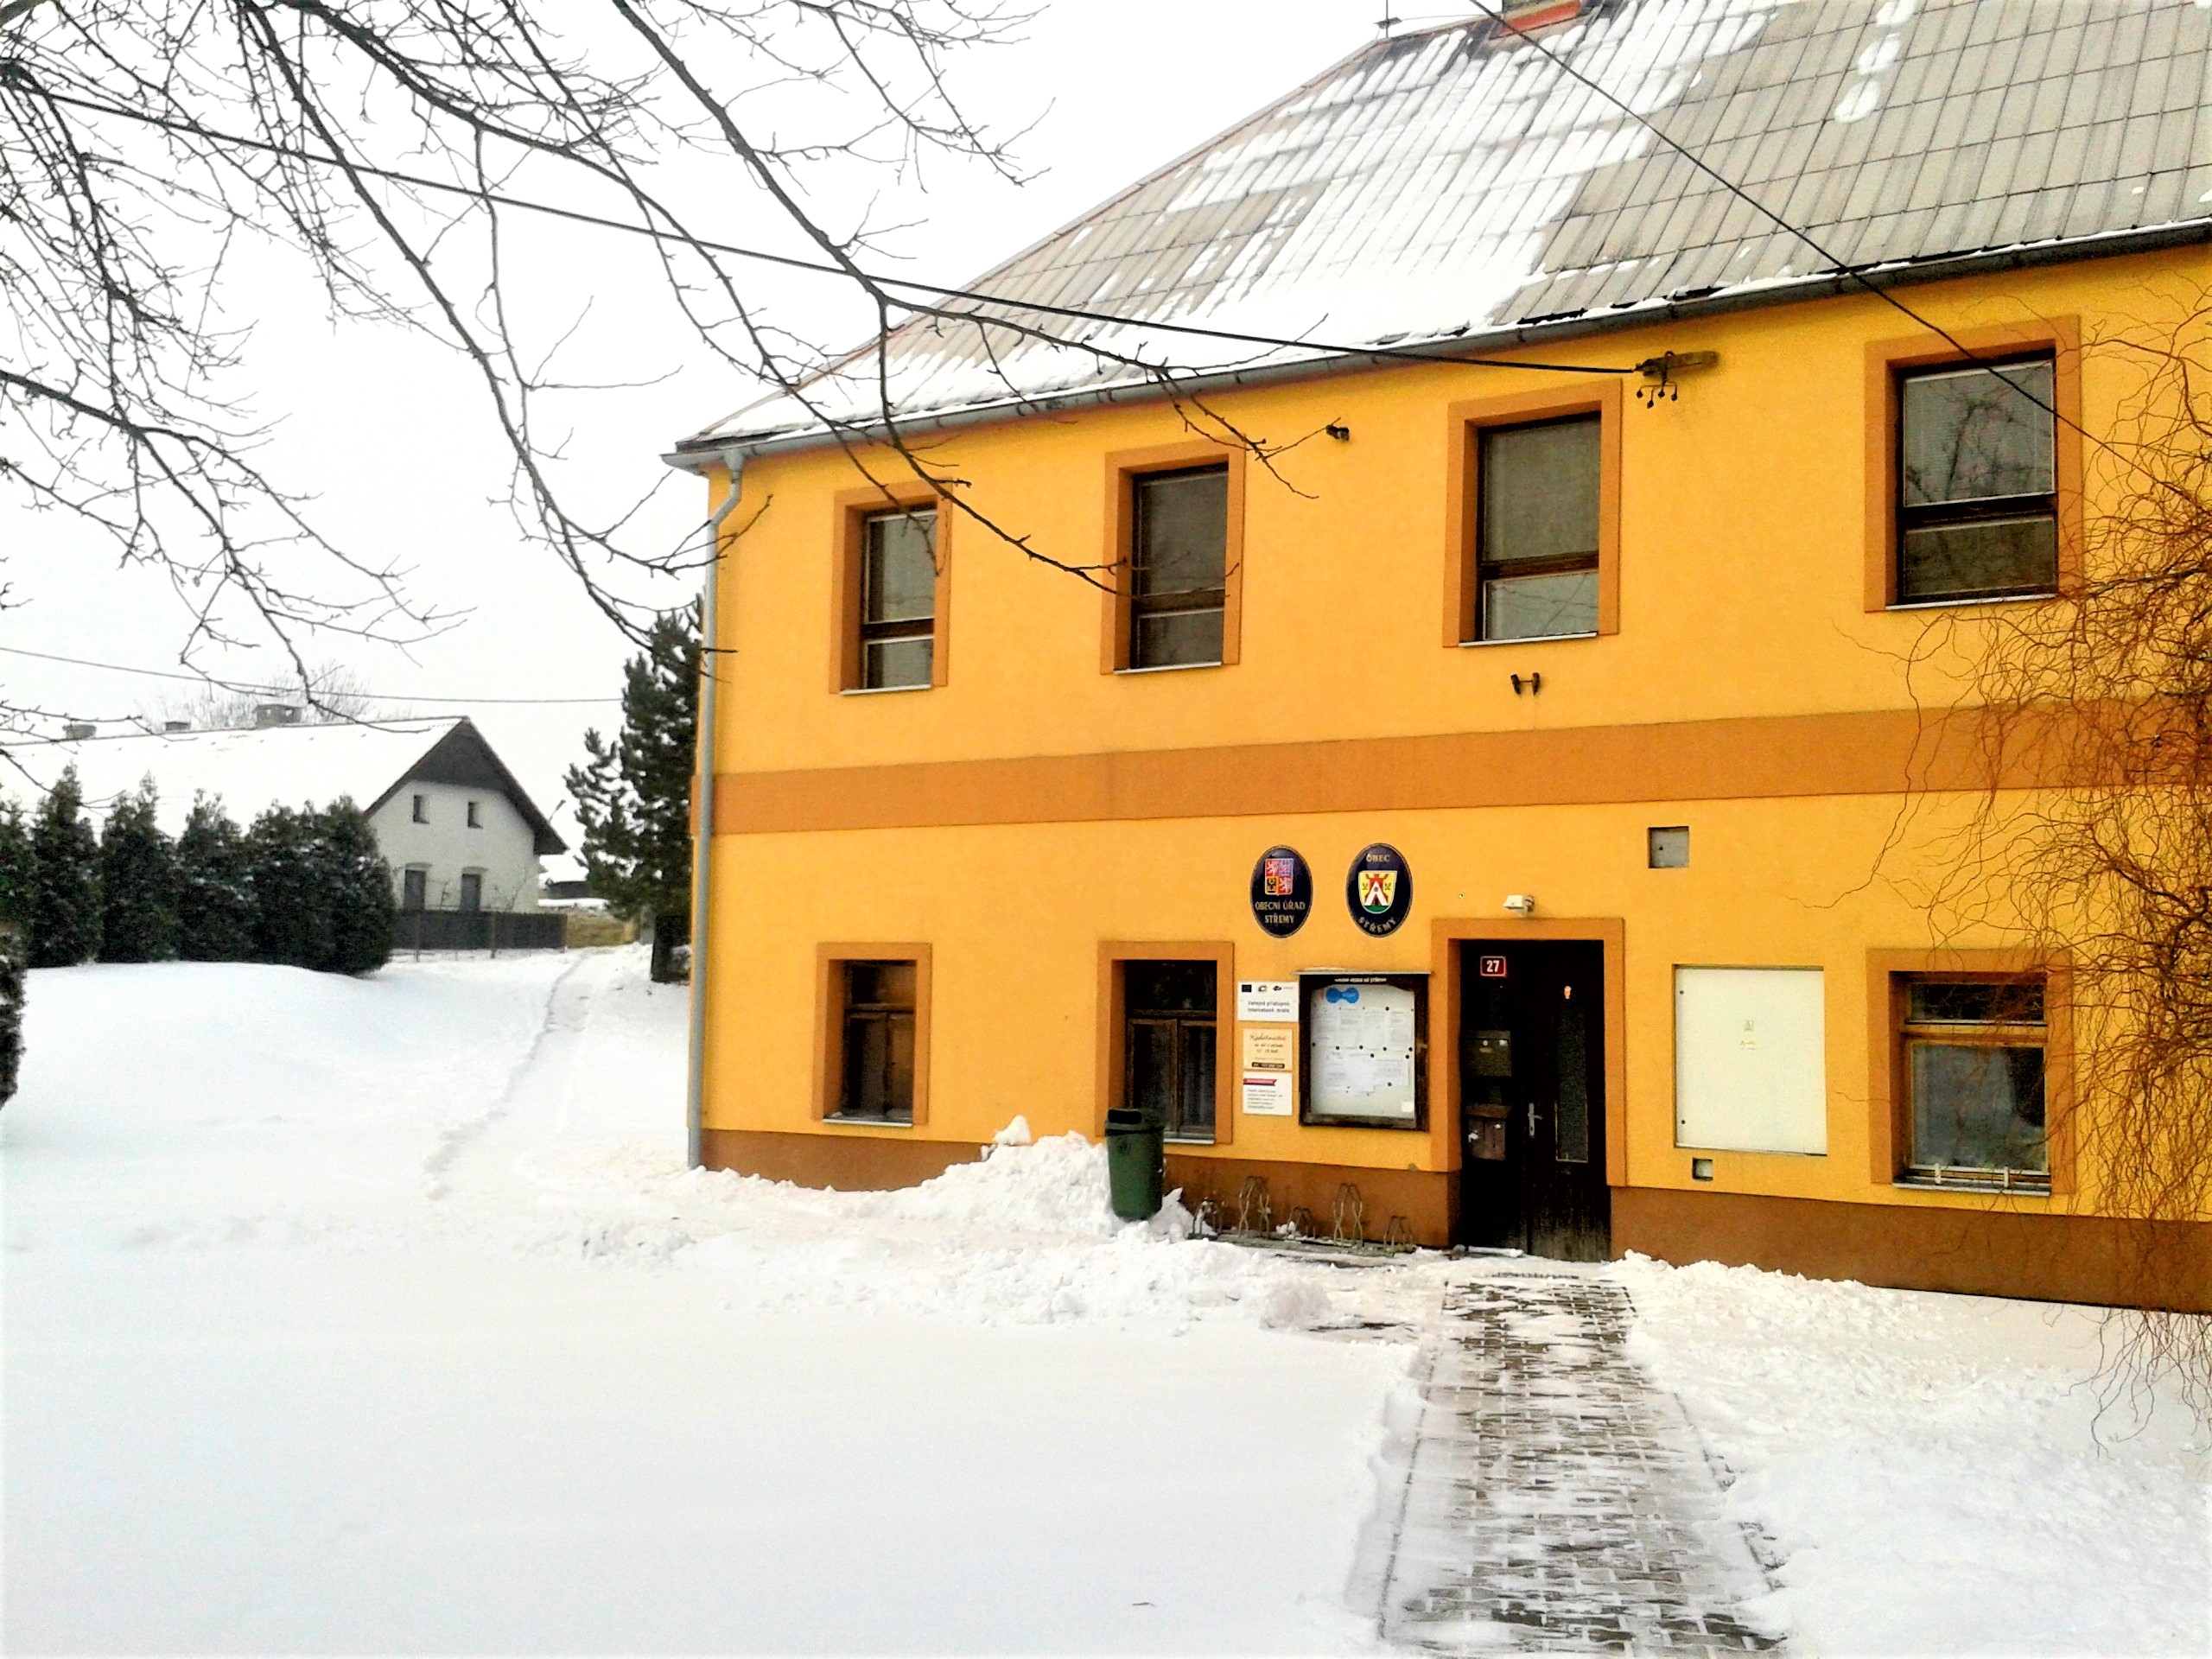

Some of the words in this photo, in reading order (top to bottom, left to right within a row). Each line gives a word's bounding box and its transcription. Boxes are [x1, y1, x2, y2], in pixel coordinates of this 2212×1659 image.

[1365, 853, 1390, 862] OBEC
[1255, 899, 1281, 911] OBECNÍ
[1282, 899, 1306, 911] ÚŘAD
[1264, 912, 1294, 924] STŘEMY
[1357, 917, 1396, 933] STŘEMY
[1486, 959, 1500, 973] 27
